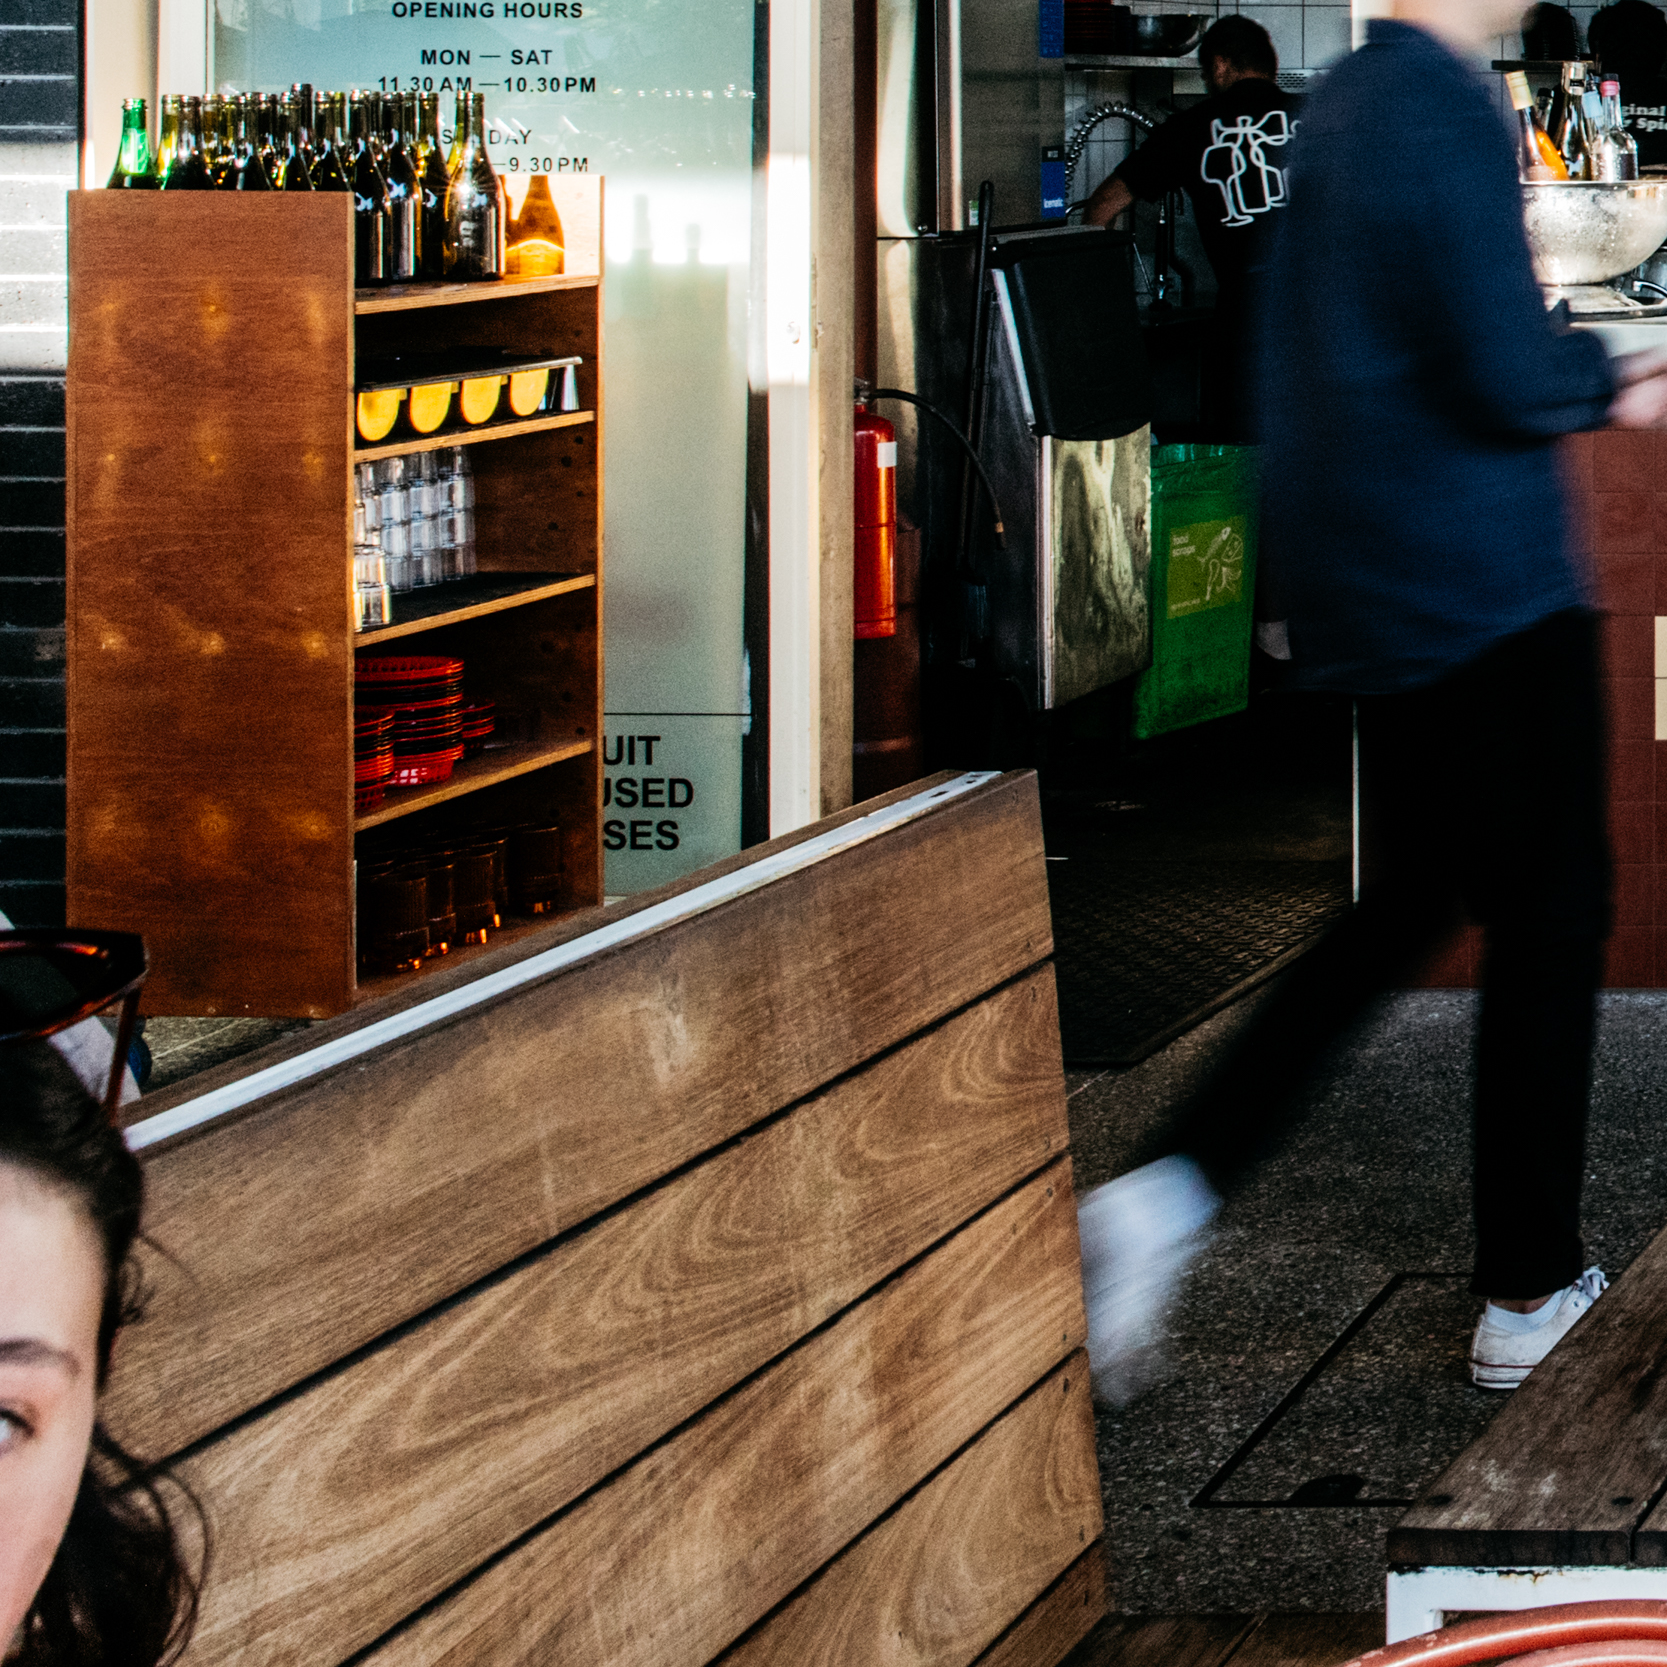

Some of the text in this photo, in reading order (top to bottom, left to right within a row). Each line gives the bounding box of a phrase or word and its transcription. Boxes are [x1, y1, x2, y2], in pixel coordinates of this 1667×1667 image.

[392, 1, 584, 20] OPENING HOURS
[420, 49, 472, 66] MON
[510, 49, 553, 66] SAT
[441, 129, 532, 146] SDAY
